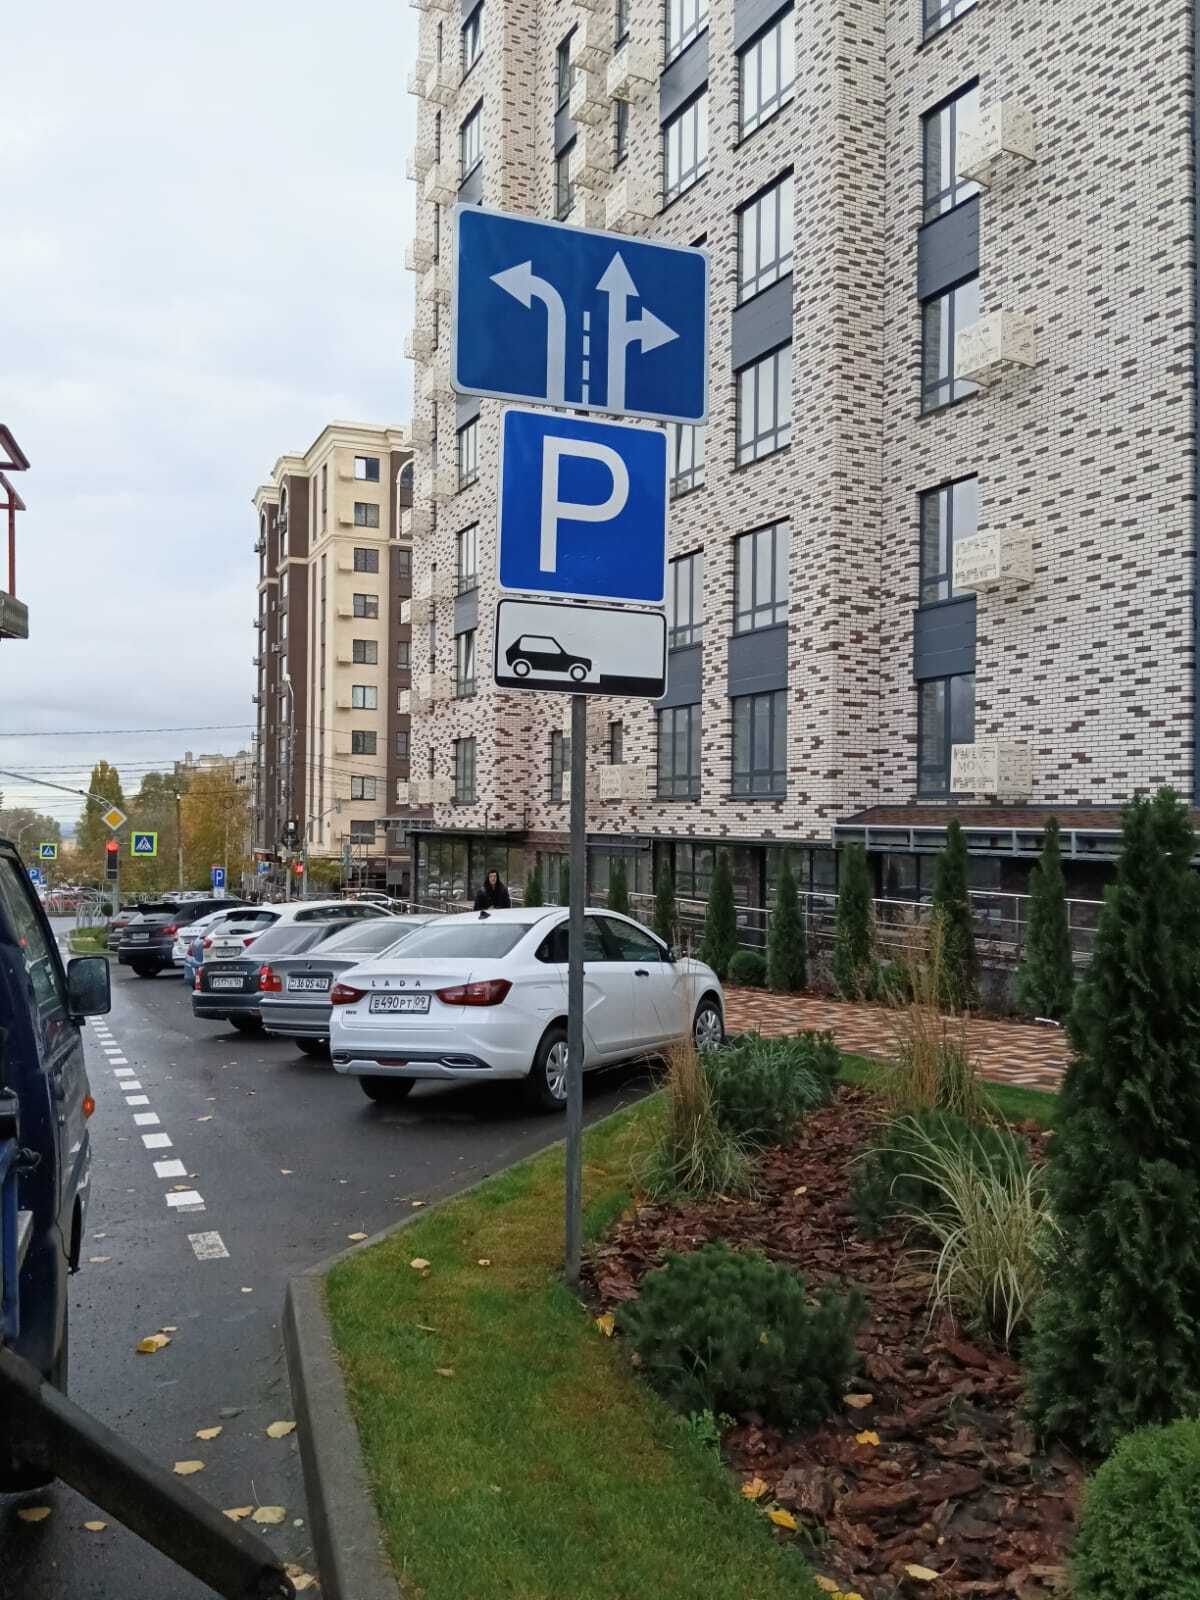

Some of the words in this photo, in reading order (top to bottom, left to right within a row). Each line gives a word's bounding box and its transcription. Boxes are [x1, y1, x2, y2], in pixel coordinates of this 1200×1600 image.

[539, 435, 630, 574] P
[216, 870, 223, 885] P
[371, 980, 421, 988] LADA
